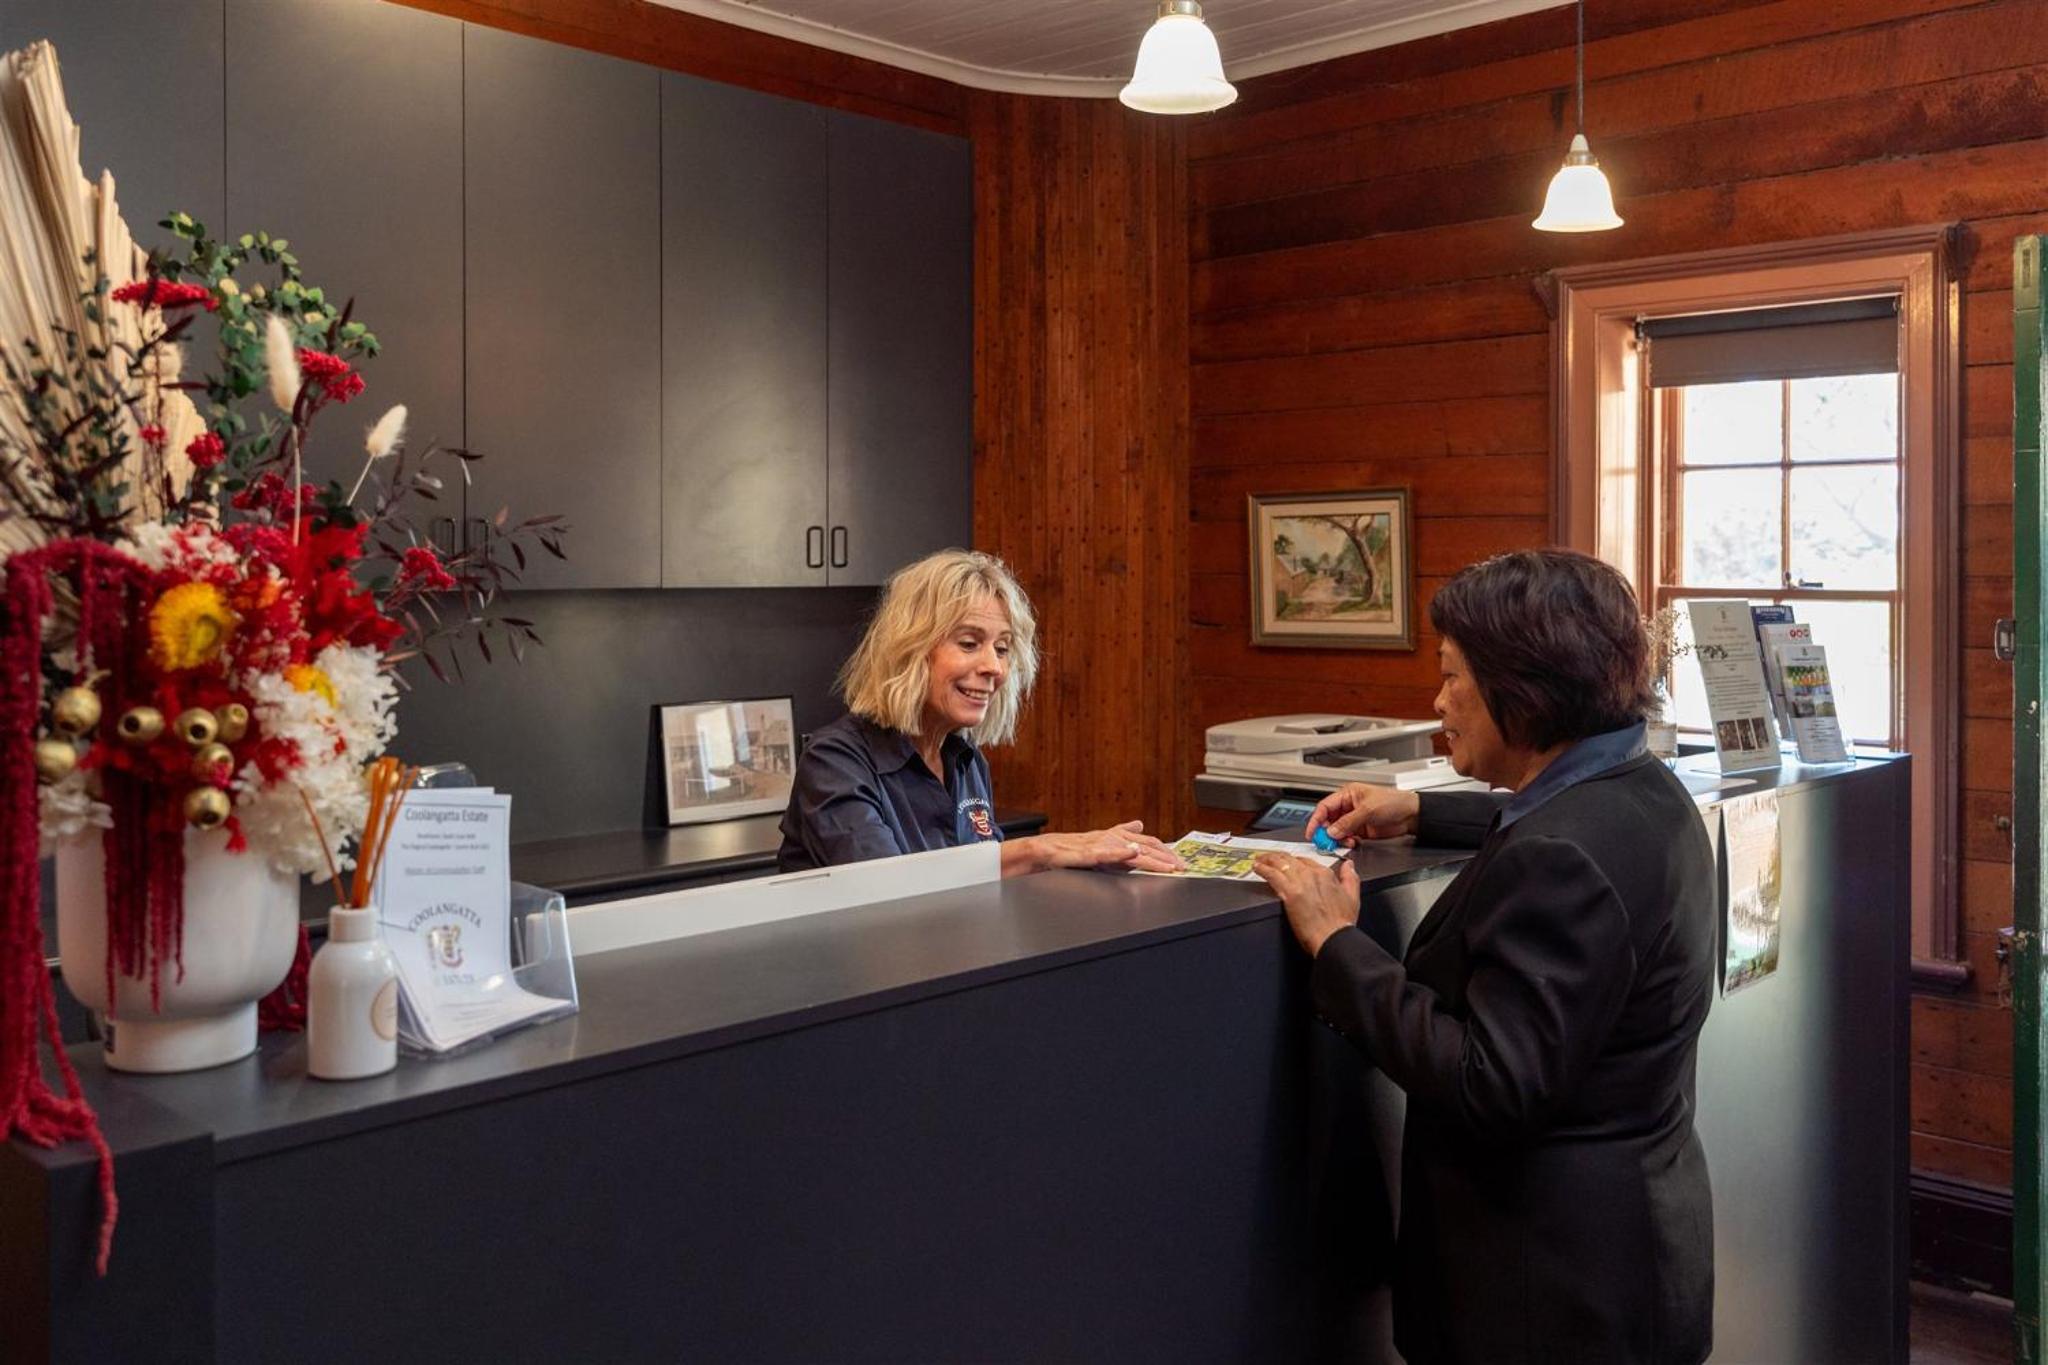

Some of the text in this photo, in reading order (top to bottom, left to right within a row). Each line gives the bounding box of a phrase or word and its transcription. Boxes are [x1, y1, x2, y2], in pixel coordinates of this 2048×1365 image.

[405, 808, 489, 824] Coolangatta Estate
[408, 902, 482, 932] COOLANGATTA
